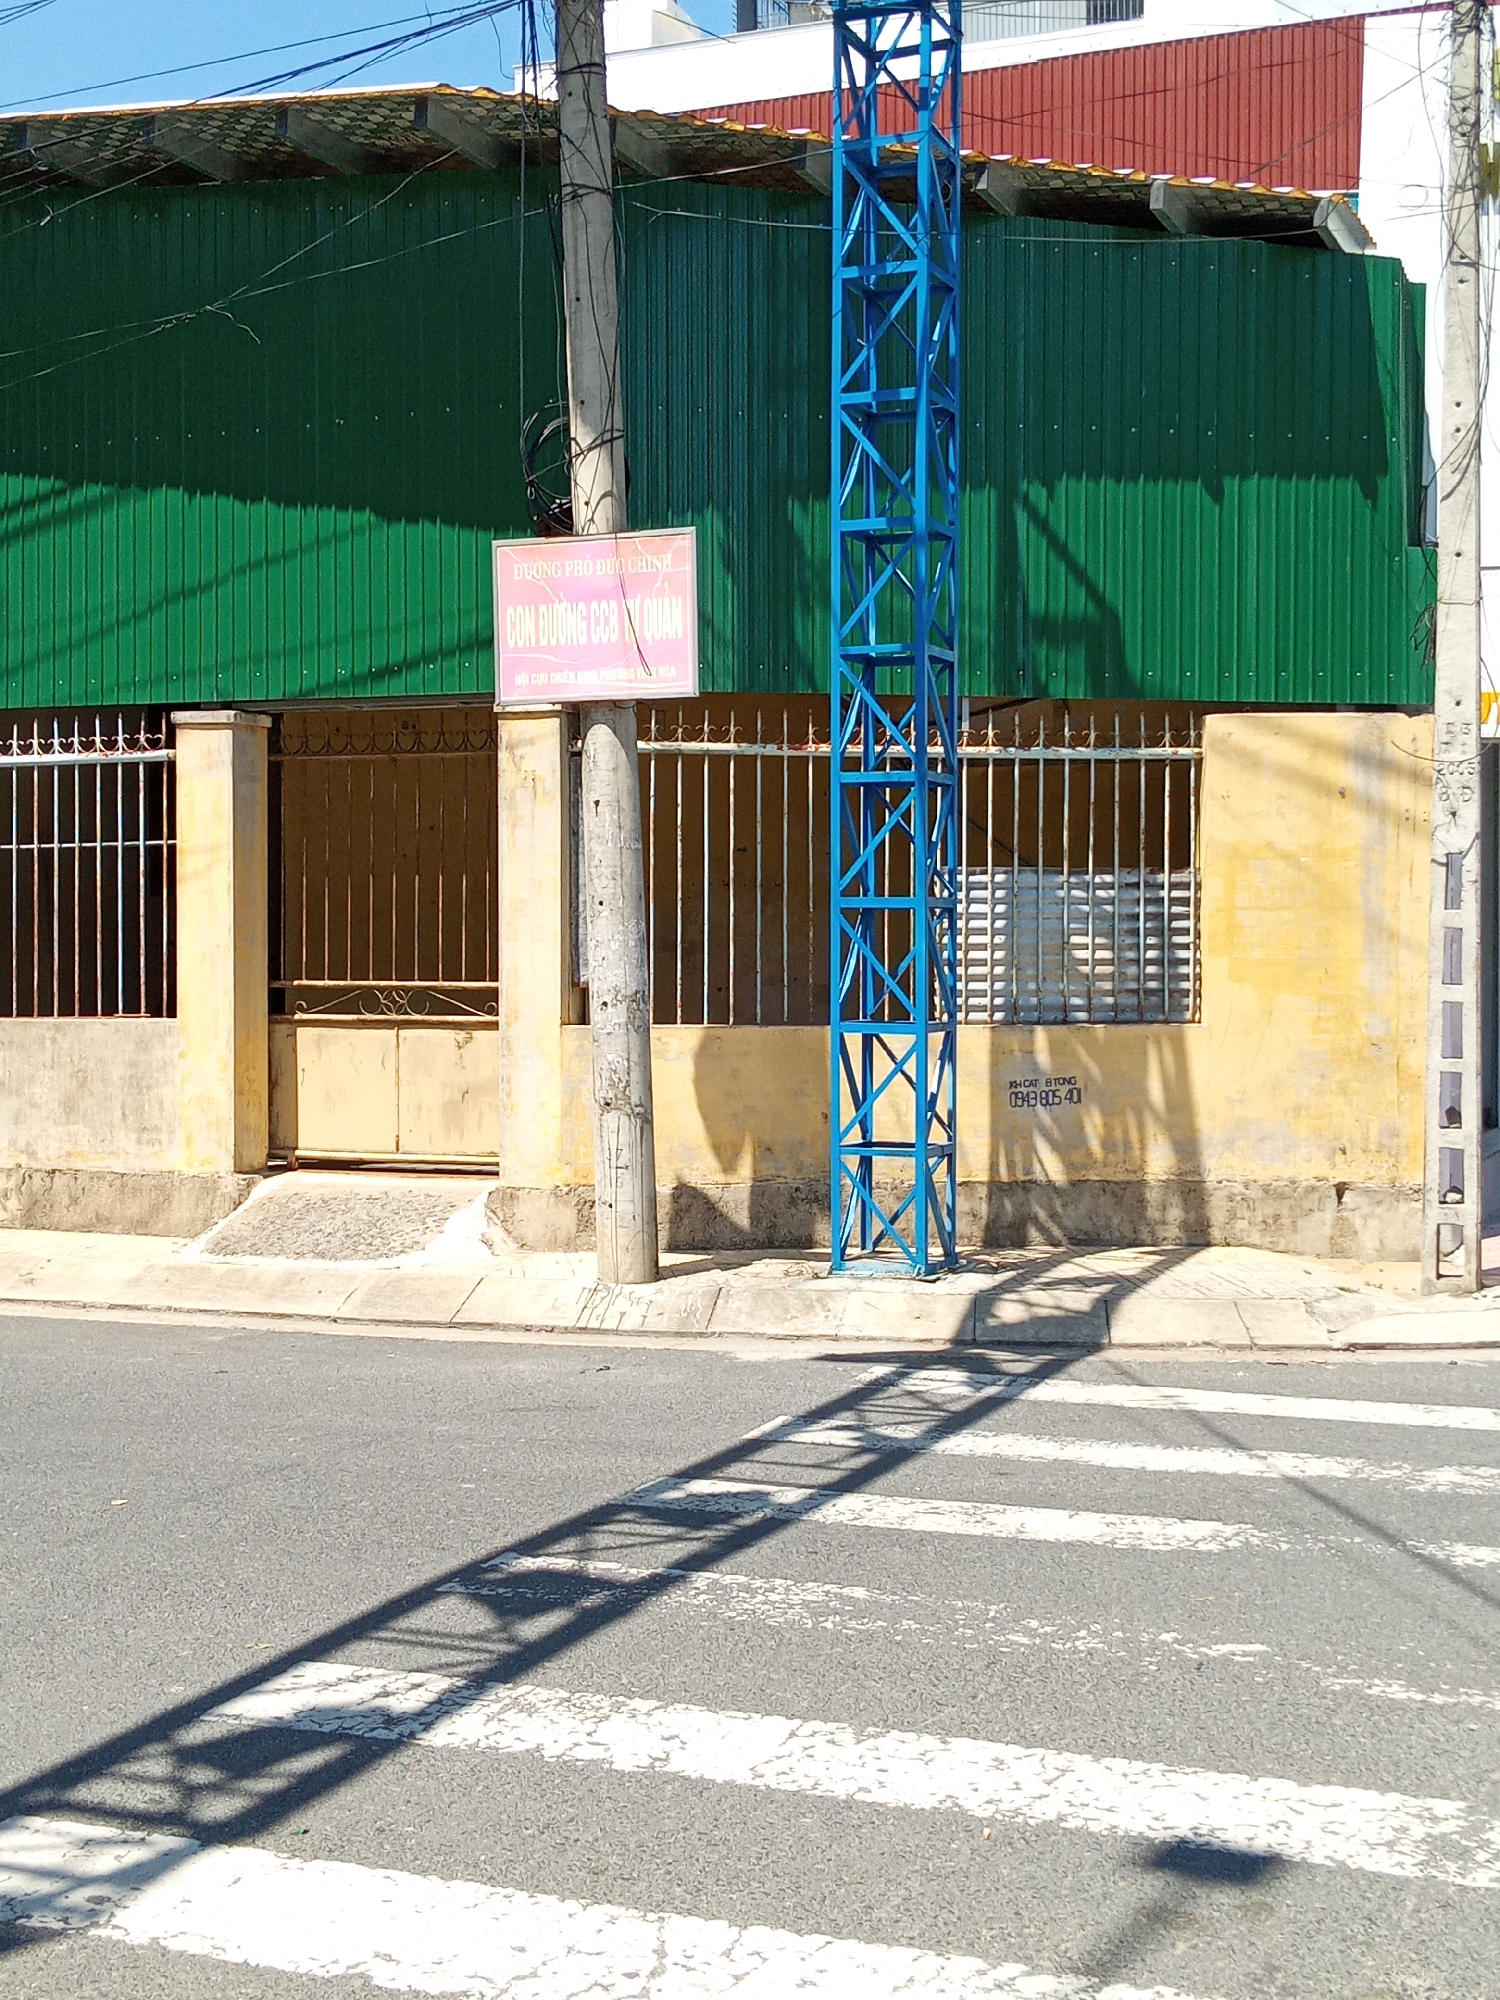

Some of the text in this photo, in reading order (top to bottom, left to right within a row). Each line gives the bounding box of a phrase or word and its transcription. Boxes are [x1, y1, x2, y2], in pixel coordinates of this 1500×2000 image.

[513, 551, 672, 579] ĐƯỜNG PHÓ ĐỨC CHÍNH
[506, 605, 535, 649] CON
[539, 591, 587, 646] ĐƯỜNG
[590, 600, 618, 644] CCB
[644, 581, 683, 646] QUẢN
[514, 671, 529, 687] HỘI
[531, 671, 549, 687] CỰU
[1063, 1087, 1082, 1105] 401
